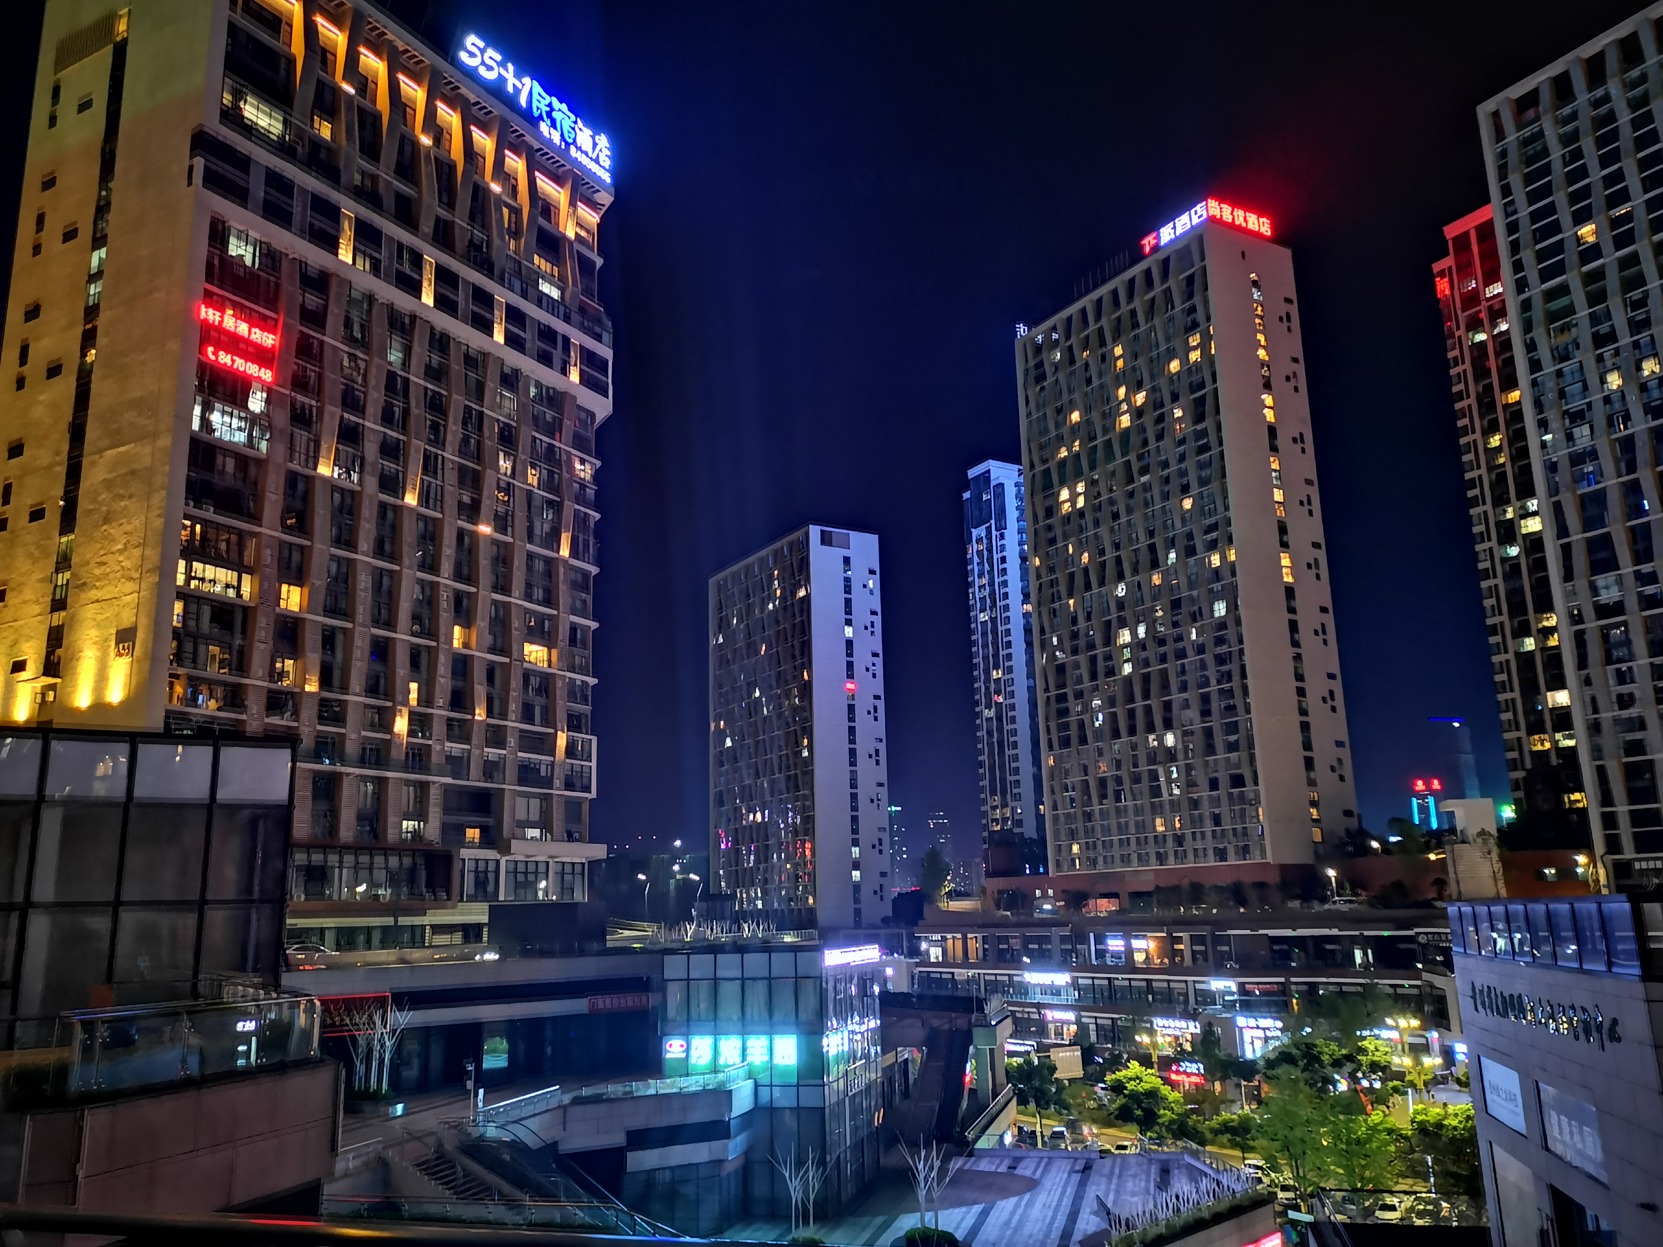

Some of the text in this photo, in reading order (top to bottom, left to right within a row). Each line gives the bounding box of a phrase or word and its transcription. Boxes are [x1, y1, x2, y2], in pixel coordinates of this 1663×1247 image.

[1208, 199, 1271, 236] 尚客优酒店
[217, 351, 272, 382] 84700848
